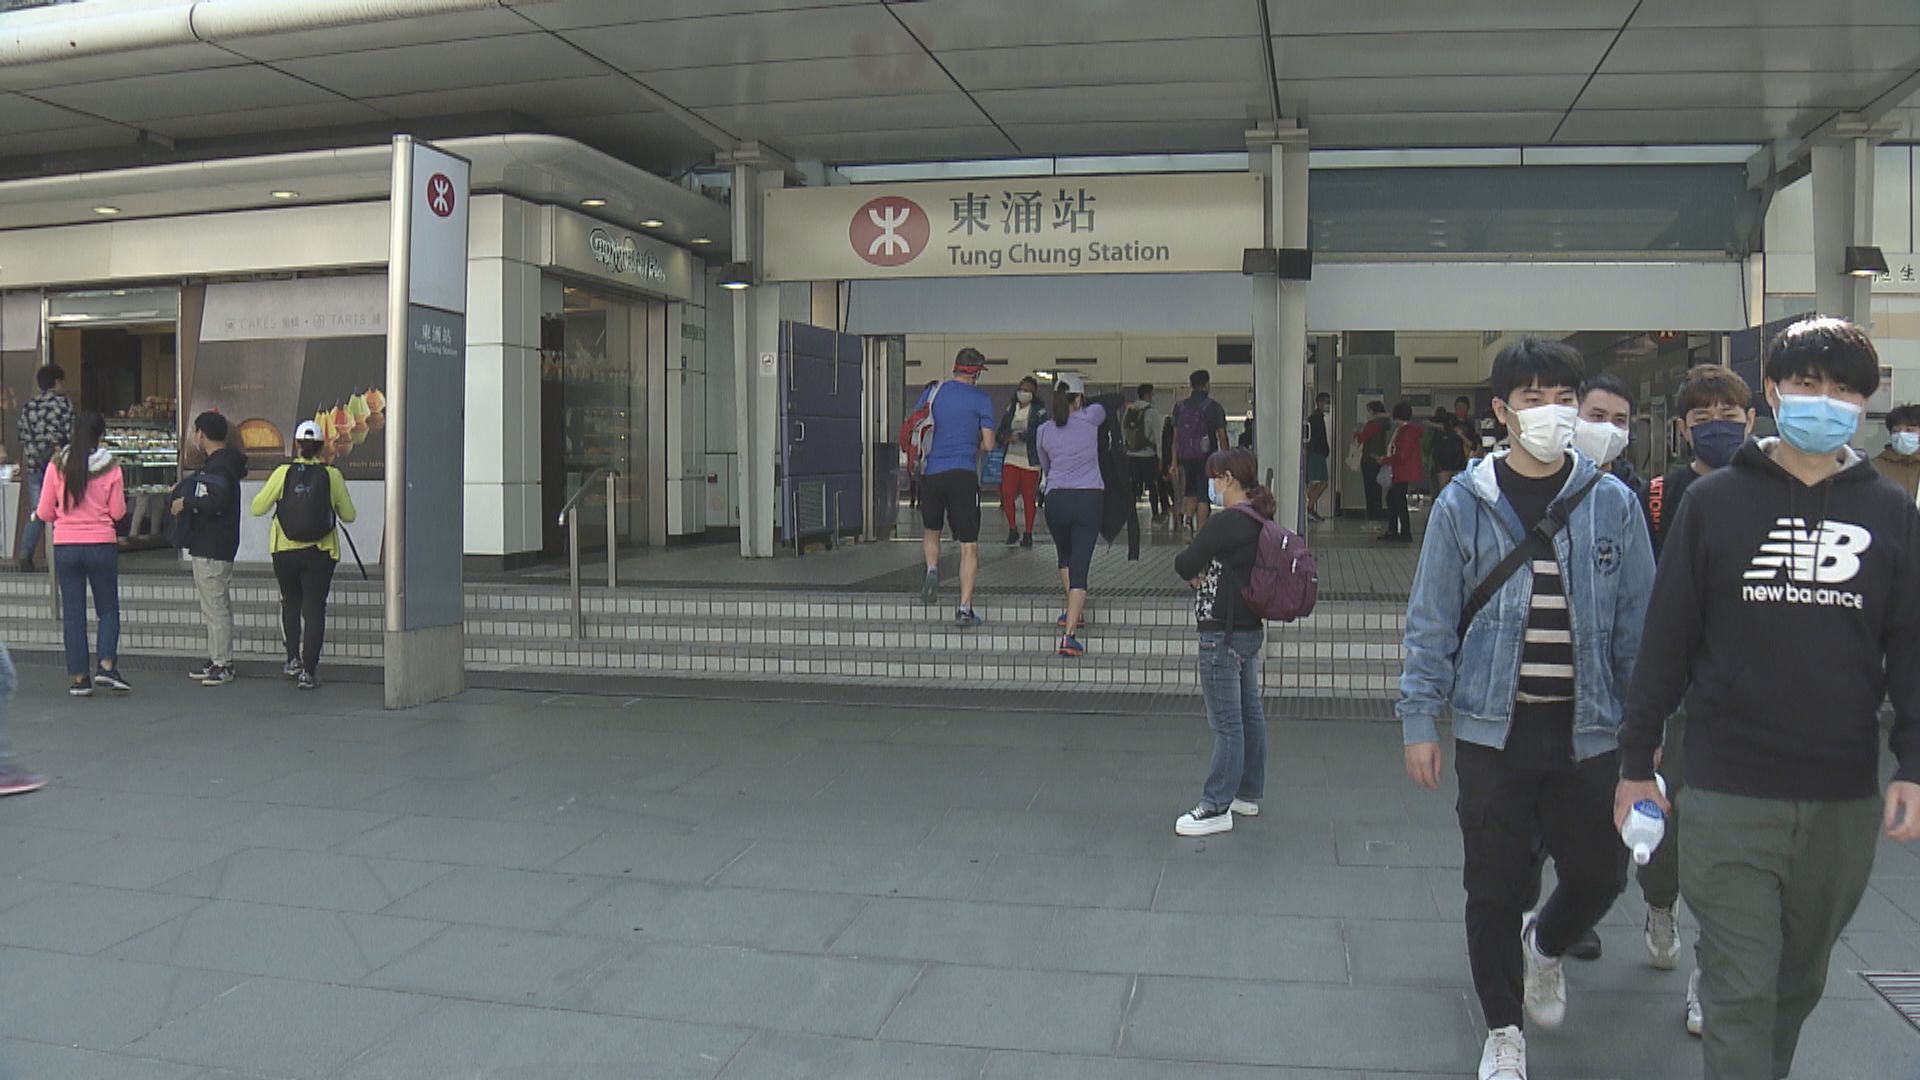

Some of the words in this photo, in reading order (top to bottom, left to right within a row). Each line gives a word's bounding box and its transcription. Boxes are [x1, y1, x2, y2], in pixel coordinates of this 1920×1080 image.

[948, 188, 1097, 236] 東涌站
[947, 246, 1003, 269] Tung
[1008, 244, 1081, 267] Chung
[1088, 240, 1169, 262] Station
[1742, 584, 1785, 602] new
